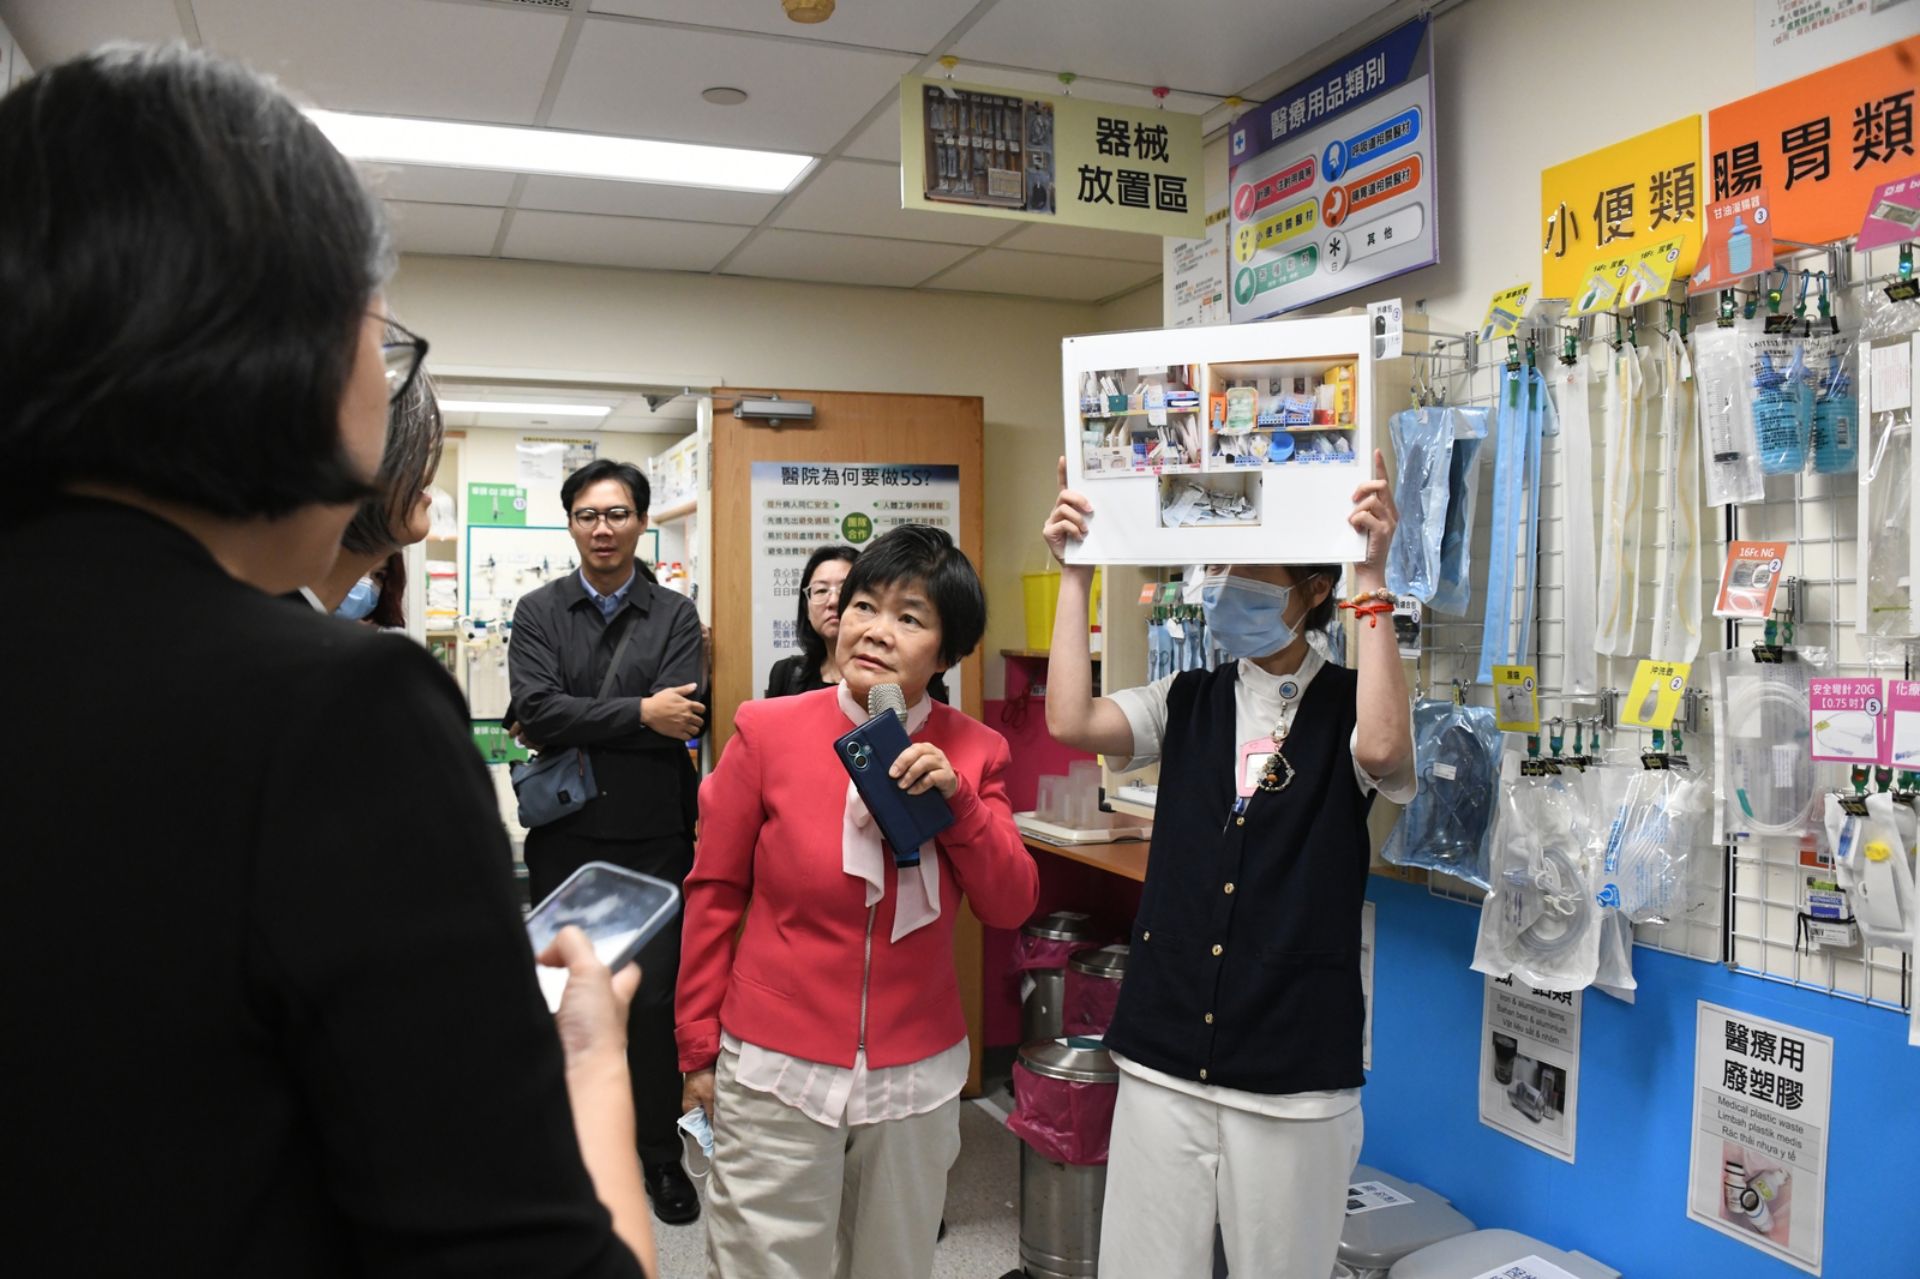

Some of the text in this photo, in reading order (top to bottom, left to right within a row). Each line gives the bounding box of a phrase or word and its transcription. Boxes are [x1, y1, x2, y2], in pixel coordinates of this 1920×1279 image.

[1271, 53, 1386, 140] 醫療用品類別
[1096, 116, 1169, 163] 器械
[1351, 120, 1411, 157] 呼吸道相關醫材
[1713, 90, 1915, 201] 腸胃類
[1077, 164, 1188, 213] 放置區
[1544, 162, 1695, 258] 小便類
[1757, 209, 1764, 221] 3
[1367, 226, 1393, 247] 其他
[781, 466, 932, 487] 醫院為何要做5S?
[847, 529, 867, 541] 合作
[1760, 548, 1774, 558] NG
[1771, 561, 1779, 570] 2
[1855, 684, 1876, 695] 20G
[1725, 1020, 1805, 1073] 醫療用
[1723, 1059, 1804, 1111] 廢塑膠
[1718, 1095, 1804, 1134] Medical plastic waste
[1718, 1109, 1803, 1149] Limbah plastik medis
[1722, 1125, 1738, 1140] Rác
